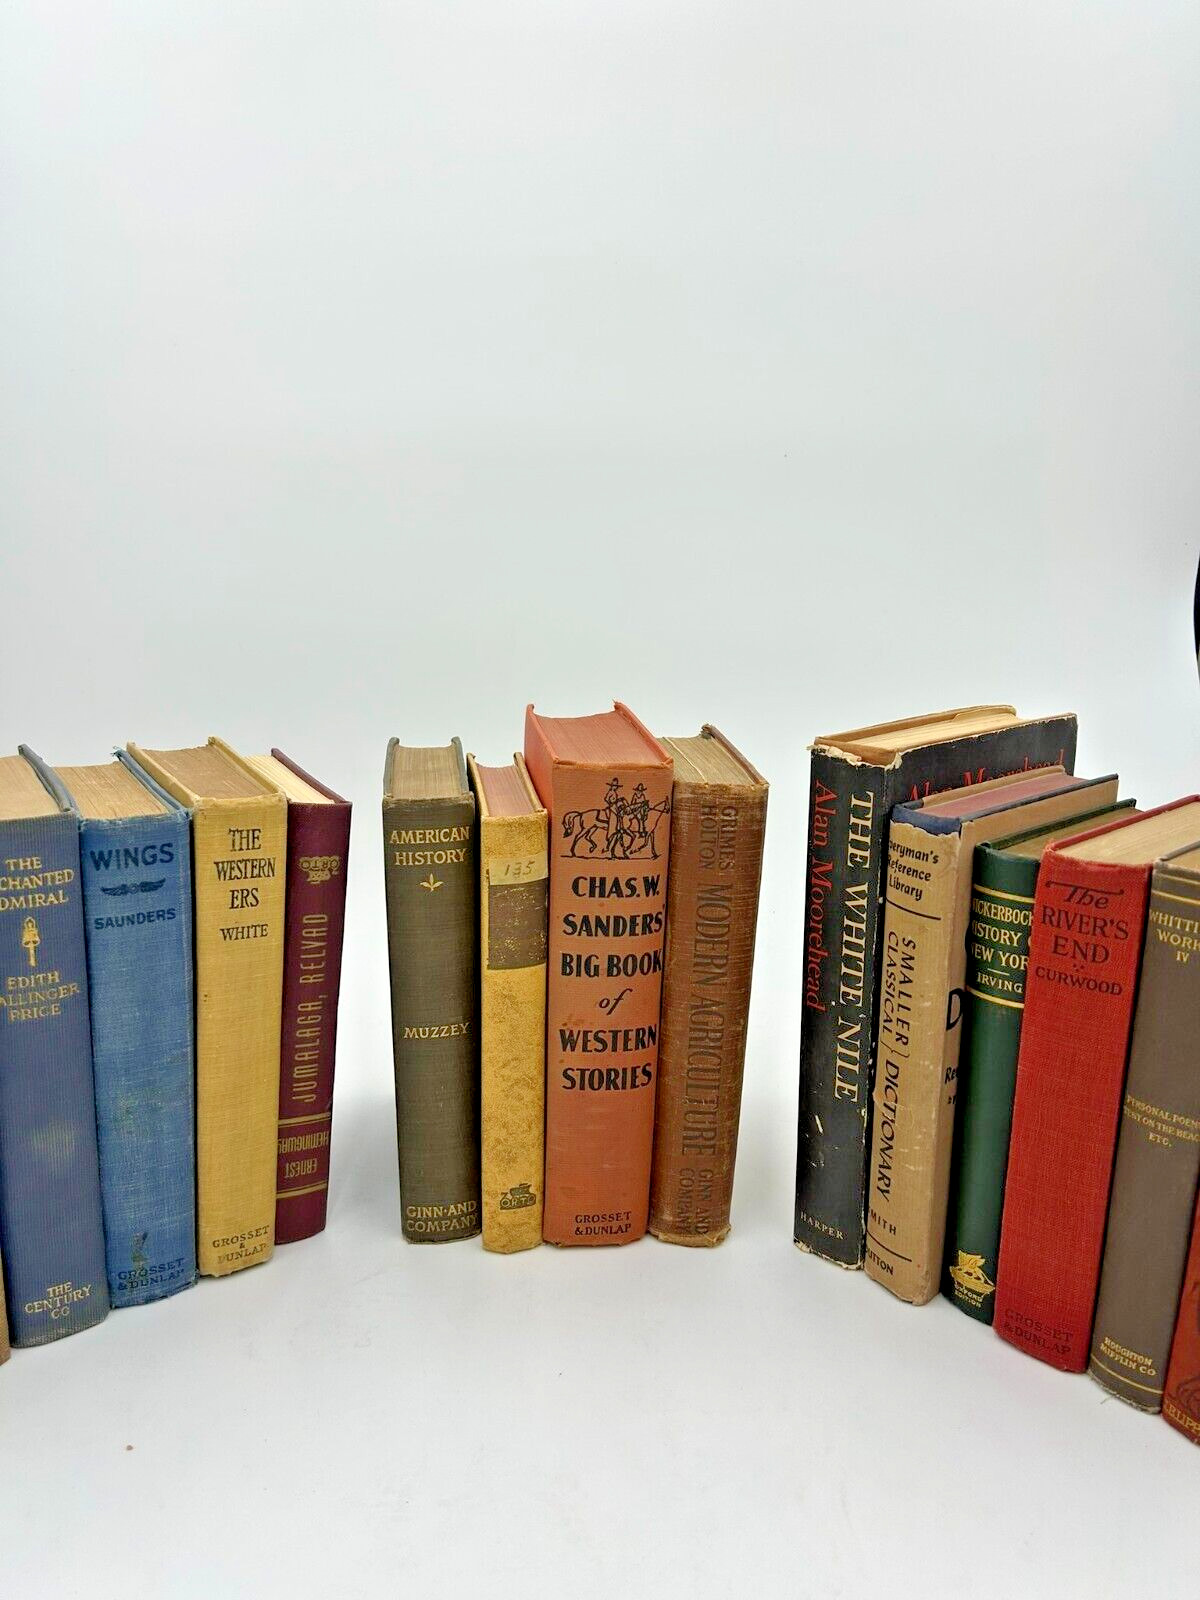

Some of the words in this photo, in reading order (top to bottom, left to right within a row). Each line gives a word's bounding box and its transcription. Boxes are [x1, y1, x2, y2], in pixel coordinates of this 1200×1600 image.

[813, 779, 838, 848] Alan
[229, 828, 261, 852] THE
[390, 825, 470, 845] AMERICAN
[701, 804, 718, 870] HOLTON
[719, 806, 738, 871] GRIMES
[847, 791, 875, 869] THE
[5, 857, 42, 871] THE
[90, 843, 175, 871] WINGS
[214, 857, 276, 881] WESTERN
[394, 848, 467, 866] HISTORY
[229, 888, 259, 909] ERS
[572, 876, 640, 898] CHAS.
[643, 874, 661, 897] W.
[889, 874, 923, 901] Library
[94, 908, 176, 930] SAUNDERS
[220, 924, 268, 942] WHITE
[1041, 904, 1129, 940] RIVER'S
[690, 882, 735, 986] MODERN
[806, 857, 834, 1012] Moorehead
[839, 882, 869, 1007] WHITE
[299, 914, 328, 984] RELVAD
[1052, 935, 1110, 963] END
[1176, 951, 1189, 964] IV
[561, 953, 600, 976] BIG
[606, 949, 662, 978] BOOK
[7, 971, 60, 990] EDITH
[882, 930, 899, 1034] CLASSICAL
[895, 937, 916, 1045] SMALLER
[977, 972, 1023, 993] IRVING
[1035, 966, 1123, 995] CURWOOD
[9, 1003, 62, 1024] PRICE
[598, 988, 633, 1015] of
[404, 1022, 471, 1039] MUZZEY
[559, 1024, 657, 1053] WESTERN
[292, 994, 328, 1103] JUMALAGA,
[834, 1016, 863, 1103] NILE
[562, 1063, 652, 1091] STORIES
[682, 996, 725, 1156] AGRICULTURE
[877, 1058, 900, 1203] DICTIONARY
[1149, 1131, 1172, 1147] ETC.
[284, 1158, 317, 1178] ERNEST
[406, 1215, 477, 1233] COMPANY
[575, 1211, 632, 1224] GROSSET
[801, 1211, 843, 1239] HARPER
[868, 1208, 897, 1235] MITH
[212, 1225, 270, 1248] GROSSET
[118, 1257, 185, 1280] GROSSET
[24, 1284, 92, 1314] CENTURY
[46, 1282, 72, 1298] THE
[954, 1290, 982, 1308] EDITION
[1005, 1308, 1073, 1341] GROSSET
[1100, 1342, 1137, 1369] MIFFLIN
[1139, 1366, 1156, 1376] CO
[1104, 1337, 1153, 1366] HOUGHTON
